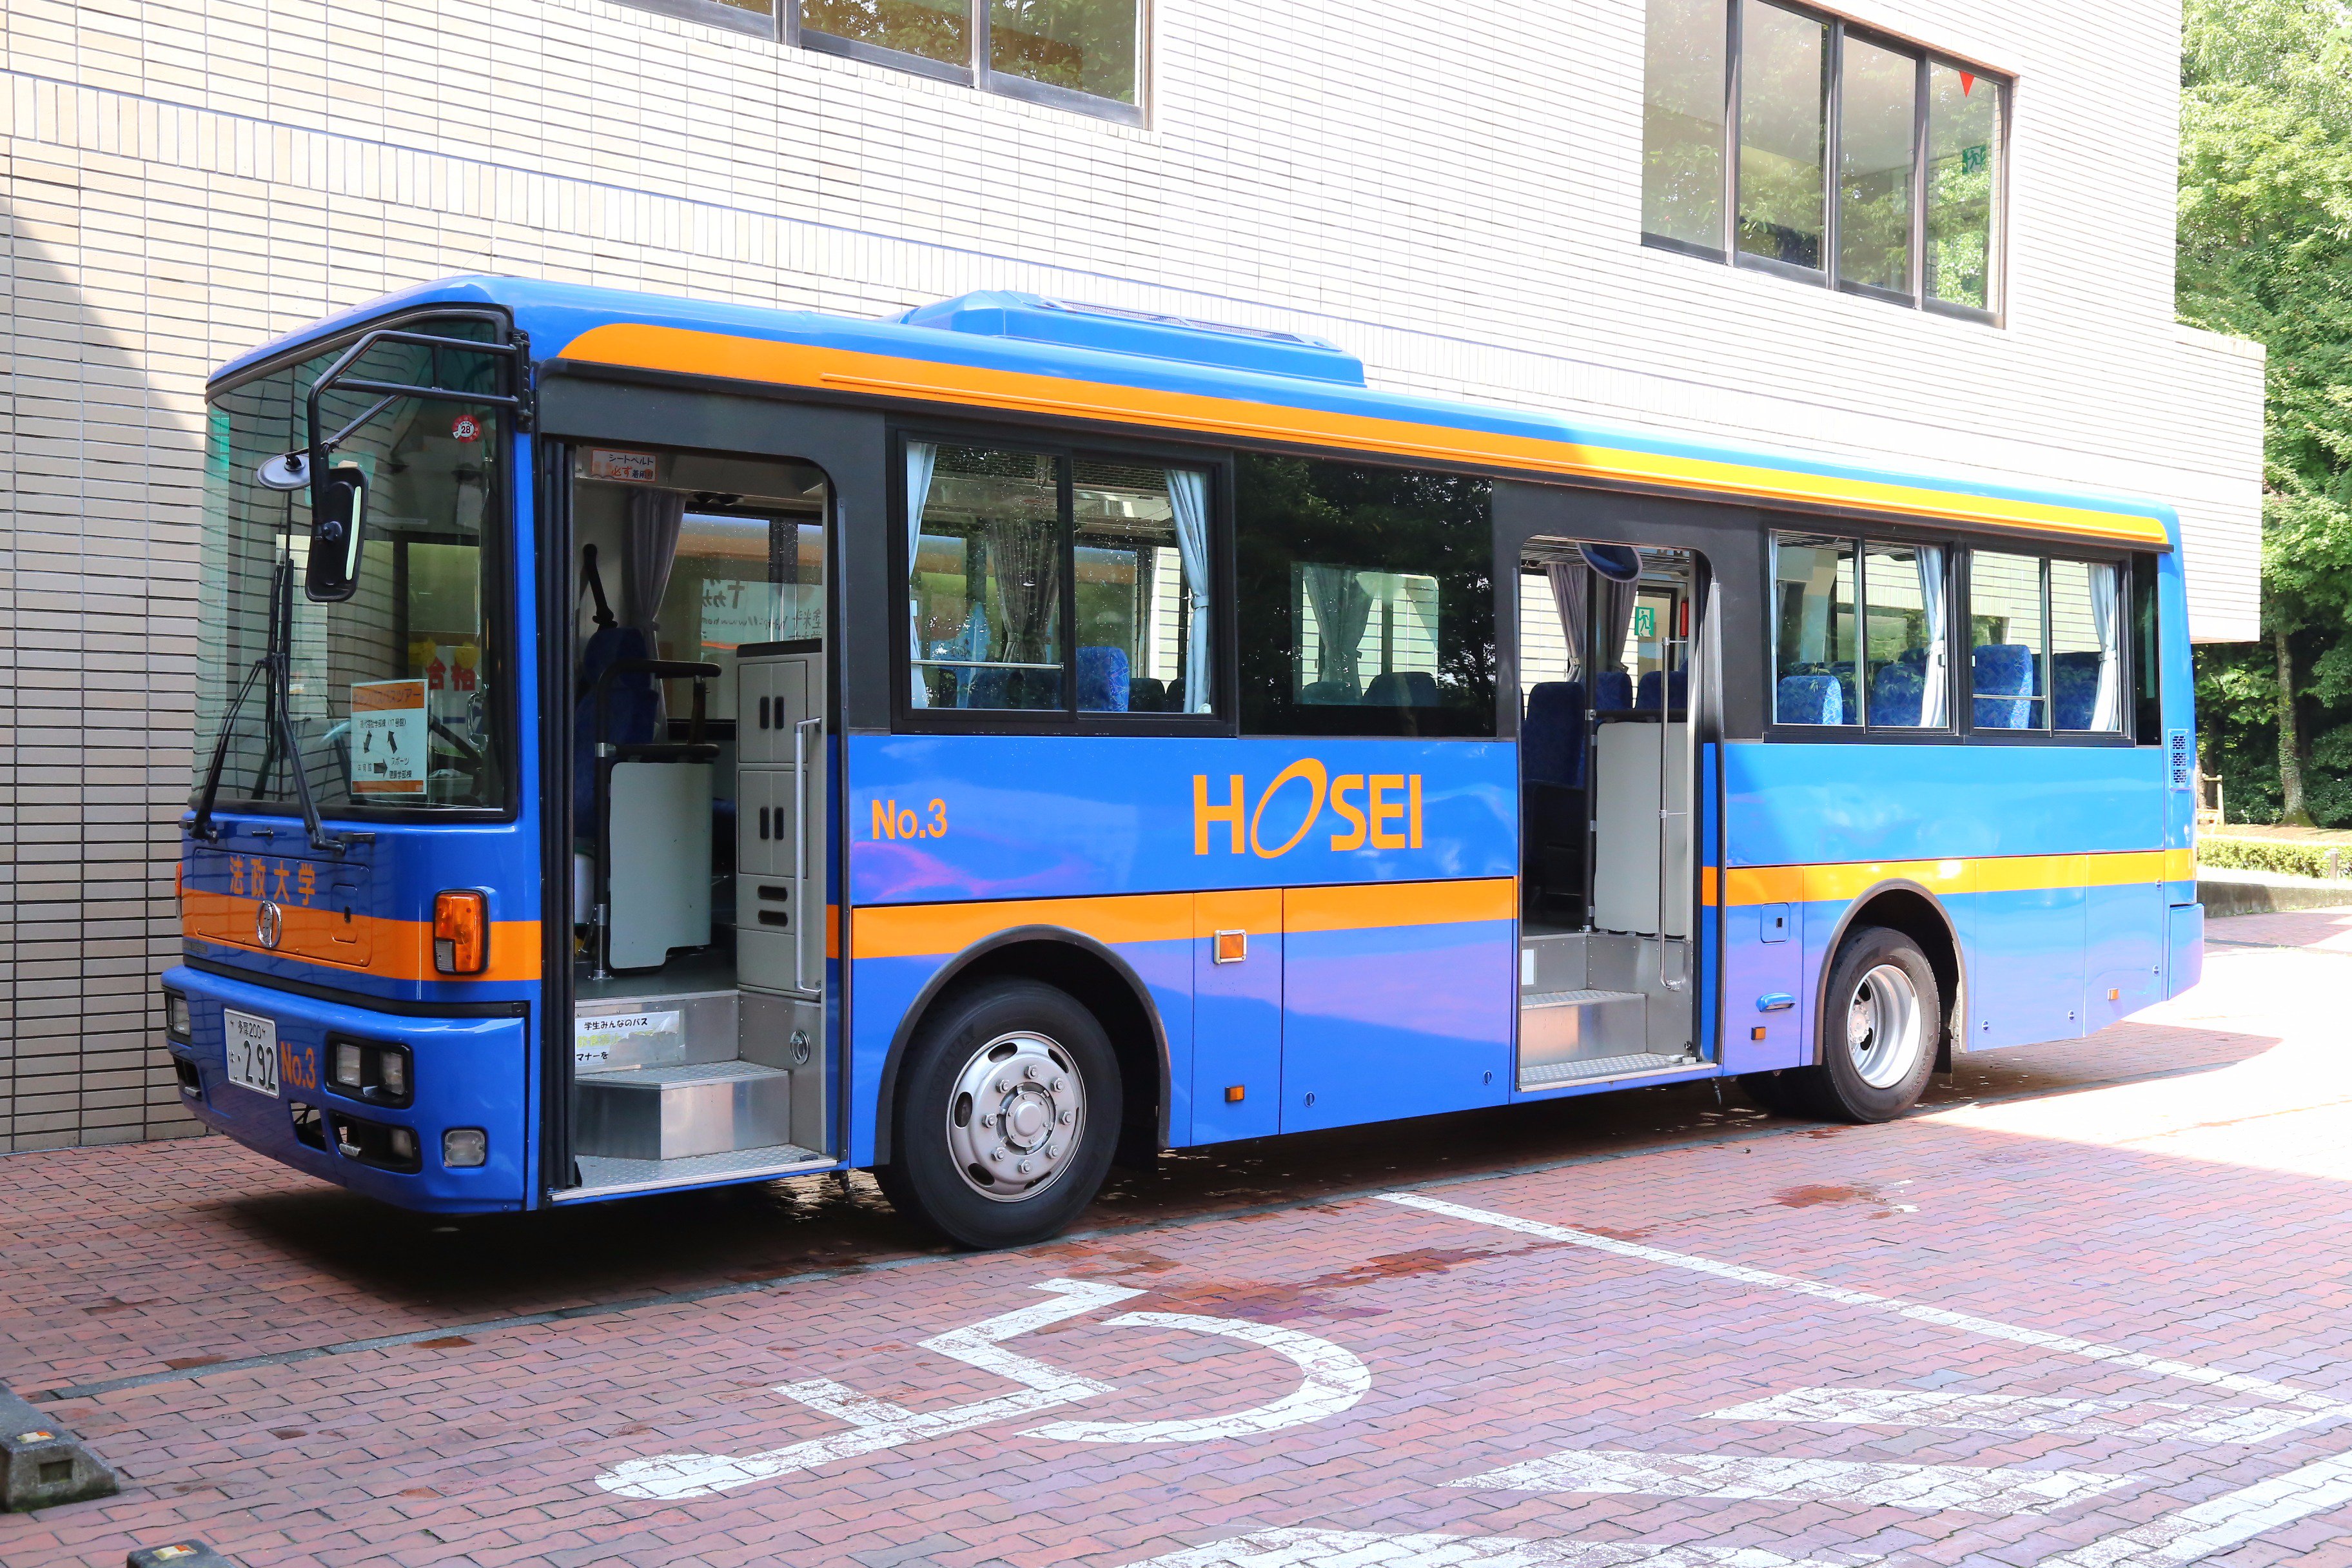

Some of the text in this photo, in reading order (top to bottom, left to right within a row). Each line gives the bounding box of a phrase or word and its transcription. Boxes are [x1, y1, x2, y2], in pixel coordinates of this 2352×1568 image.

[461, 426, 471, 434] 28
[609, 454, 654, 466] シートベルト
[391, 756, 409, 765] スポーツ
[872, 799, 948, 839] No.3
[1193, 758, 1423, 859] HOSEI
[230, 855, 316, 906] 法政大学
[584, 1017, 648, 1030] 学生みんなのバス
[280, 1041, 316, 1090] No.3
